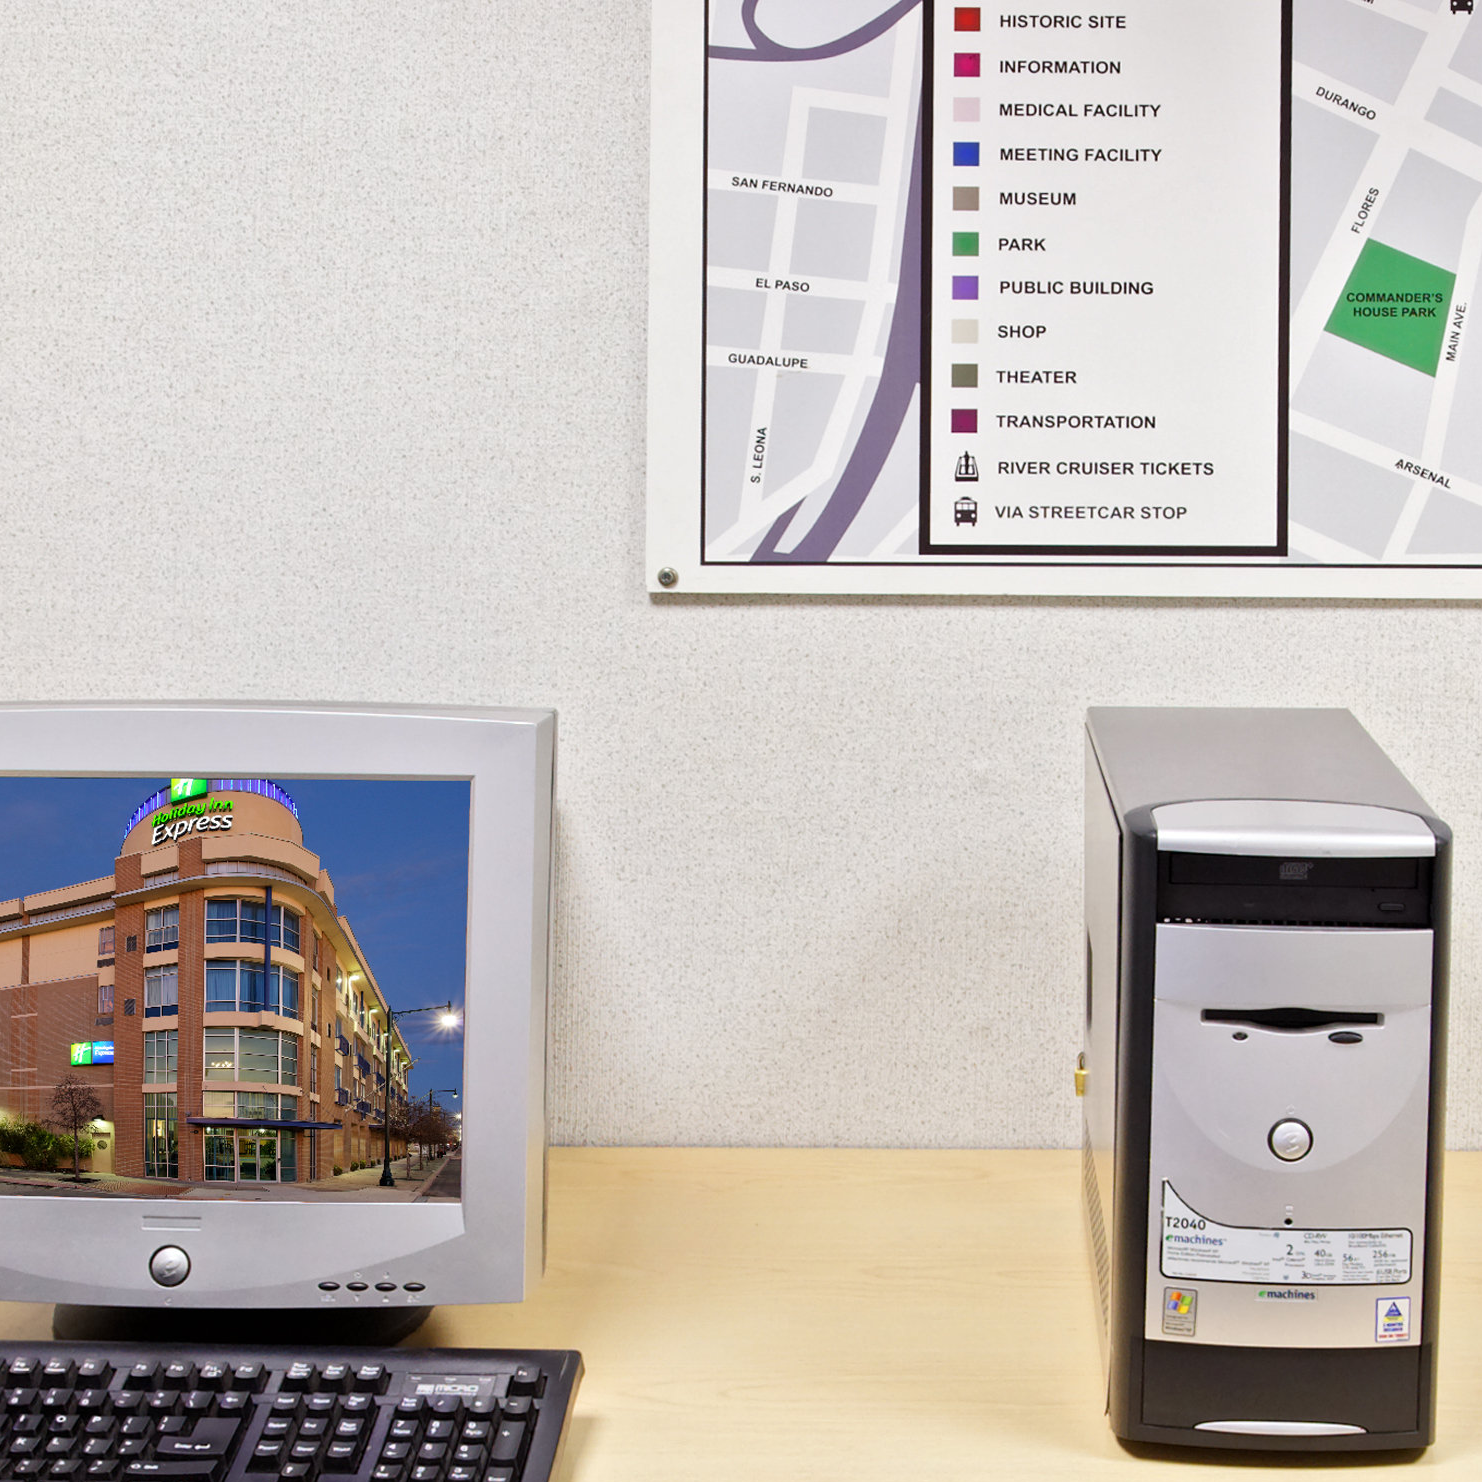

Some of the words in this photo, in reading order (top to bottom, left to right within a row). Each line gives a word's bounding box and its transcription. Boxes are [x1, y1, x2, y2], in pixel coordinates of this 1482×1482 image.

[1001, 15, 1081, 28] HISTORIC
[1089, 16, 1125, 28] SITE
[1000, 61, 1120, 74] INFORMATION
[1316, 87, 1376, 120] DURANGO
[1000, 104, 1078, 116] MEDICAL
[1084, 105, 1160, 117] FACILITY
[1001, 148, 1078, 161] MEETING
[1085, 149, 1161, 161] FACILITY
[732, 177, 758, 188] SAN
[762, 180, 832, 197] FERNANDO
[1000, 193, 1076, 205] MUSEUM
[1351, 188, 1379, 233] FLORES
[999, 238, 1045, 251] PARK
[756, 278, 770, 288] EL
[775, 280, 809, 292] PASO
[1000, 281, 1063, 294] PUBLIC
[1071, 282, 1153, 294] BUILDING
[1346, 293, 1443, 303] COMMANDER'S
[1354, 307, 1397, 317] HOUSE
[1402, 307, 1436, 317] PARK
[1450, 301, 1467, 330] AVE.
[998, 326, 1046, 338] SHOP
[1446, 331, 1460, 361] MAIN
[728, 353, 807, 368] GUADALUPE
[997, 371, 1076, 383] THEATER
[997, 416, 1155, 428] TRANSPORTATION
[753, 428, 766, 468] LEONA
[999, 462, 1050, 474] RIVER
[1057, 462, 1133, 475] CRUISER
[1140, 463, 1213, 475] TICKETS
[1395, 459, 1450, 488] ARSENAL
[750, 470, 761, 484] S.
[995, 506, 1023, 518] VIA
[1029, 506, 1134, 518] STREETCAR
[1141, 507, 1187, 519] STOP
[152, 803, 206, 827] Holiday
[208, 797, 234, 812] Inn
[151, 814, 233, 845] Express
[1166, 1216, 1206, 1230] T2040
[1286, 1244, 1294, 1256] 2
